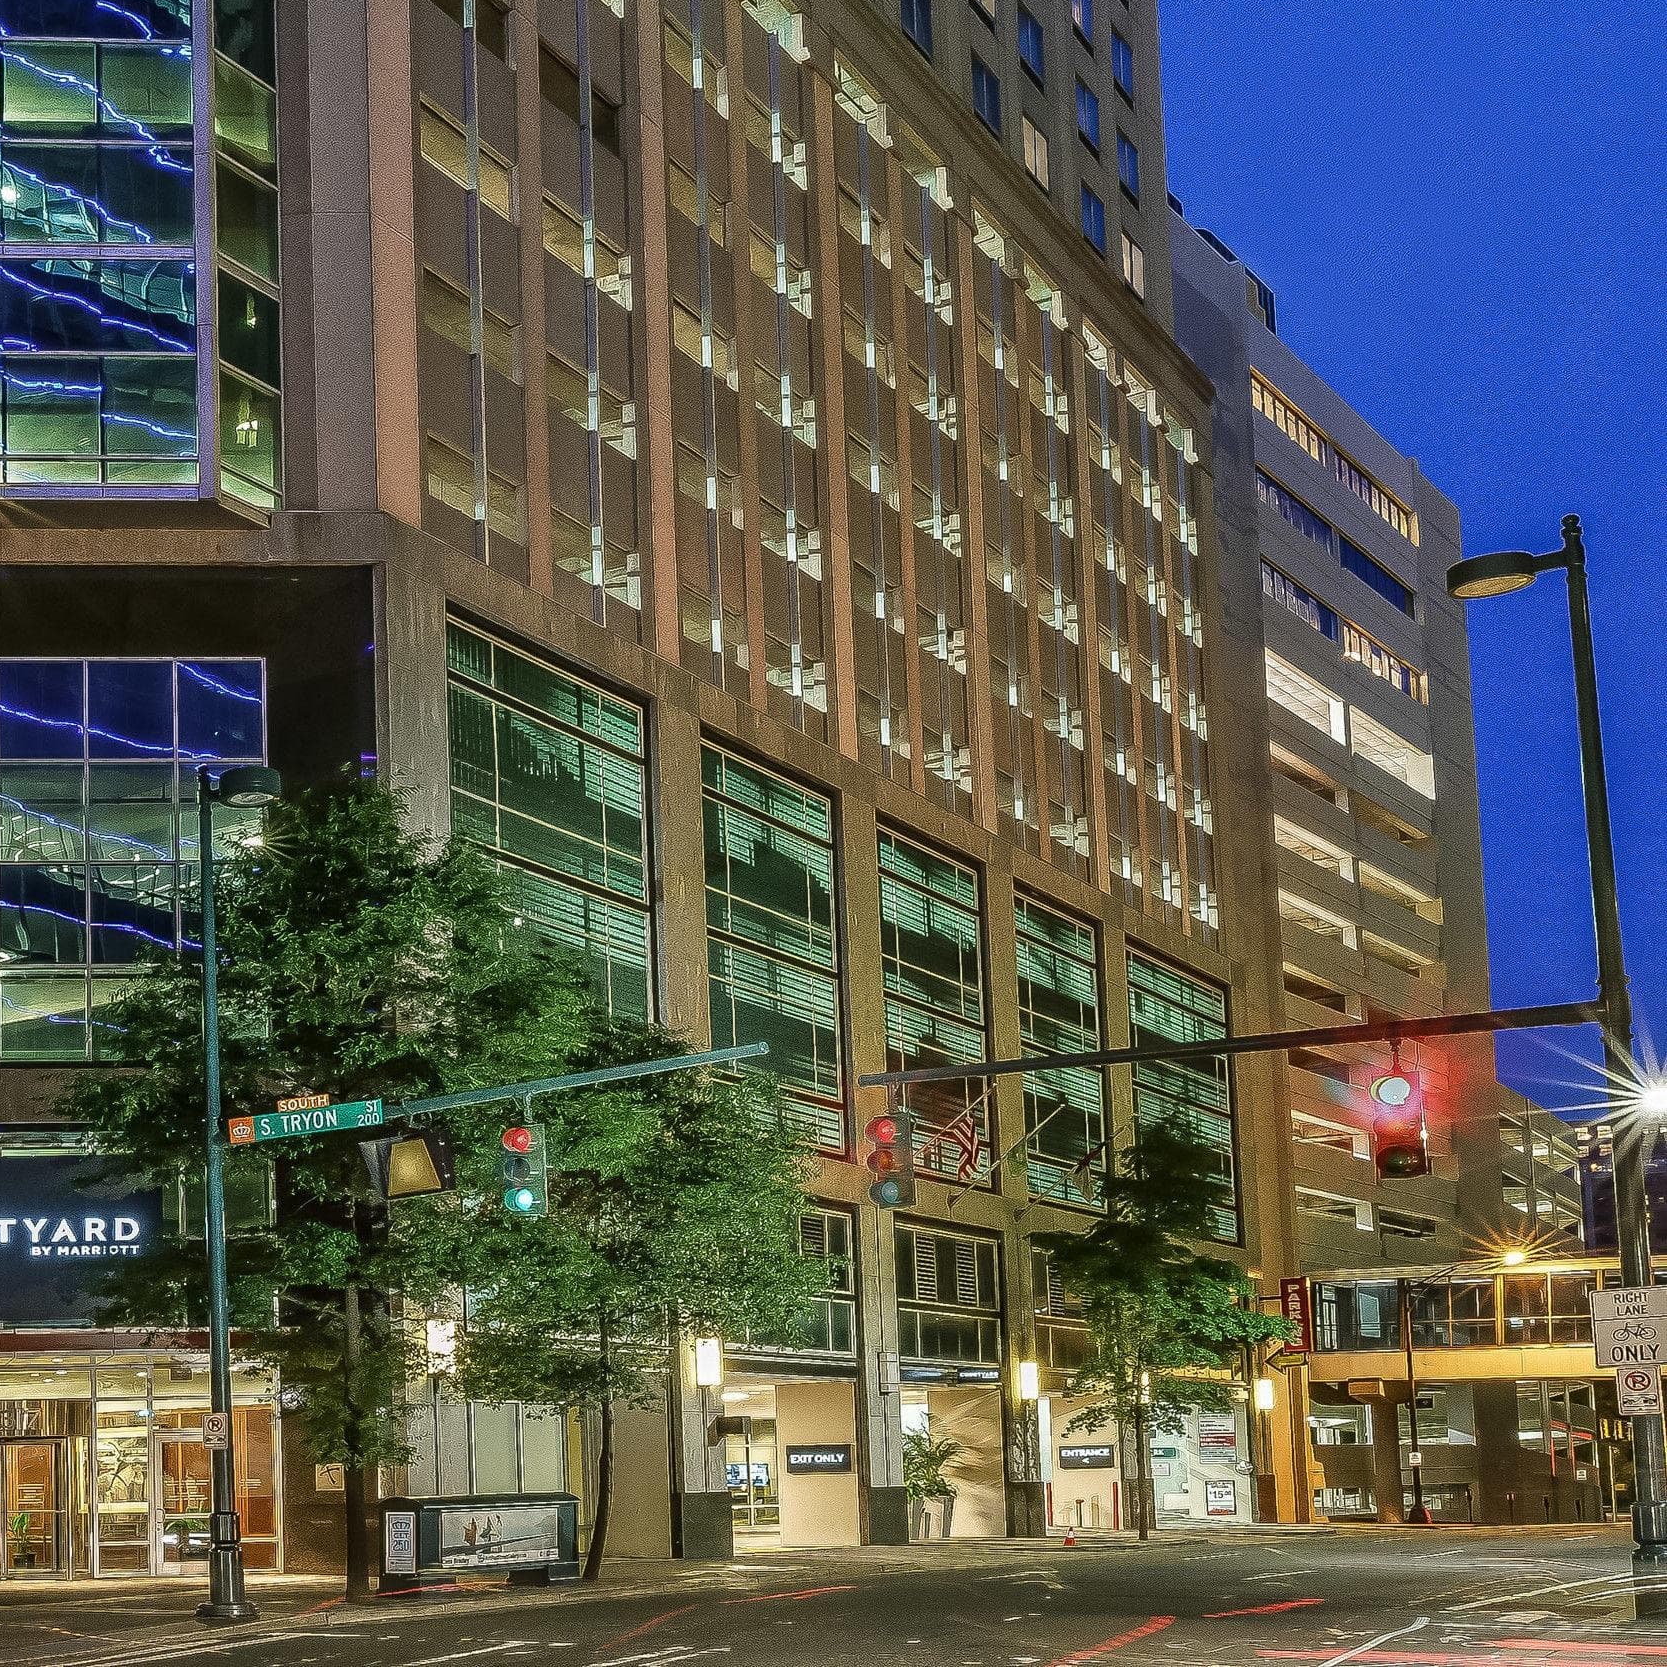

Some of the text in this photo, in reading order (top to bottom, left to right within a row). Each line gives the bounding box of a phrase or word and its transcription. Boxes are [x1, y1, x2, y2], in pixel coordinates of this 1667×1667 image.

[279, 1096, 328, 1111] SOUTH
[260, 1100, 379, 1135] S. TRYON ST
[357, 1113, 380, 1127] 200
[31, 1244, 140, 1256] BY MARRIOTT
[1613, 1292, 1649, 1303] RIGHT
[1616, 1304, 1649, 1317] LANE
[1612, 1343, 1660, 1363] ONLY
[789, 1453, 845, 1464] EXIT ONLY
[1061, 1448, 1110, 1457] ENTRANCE
